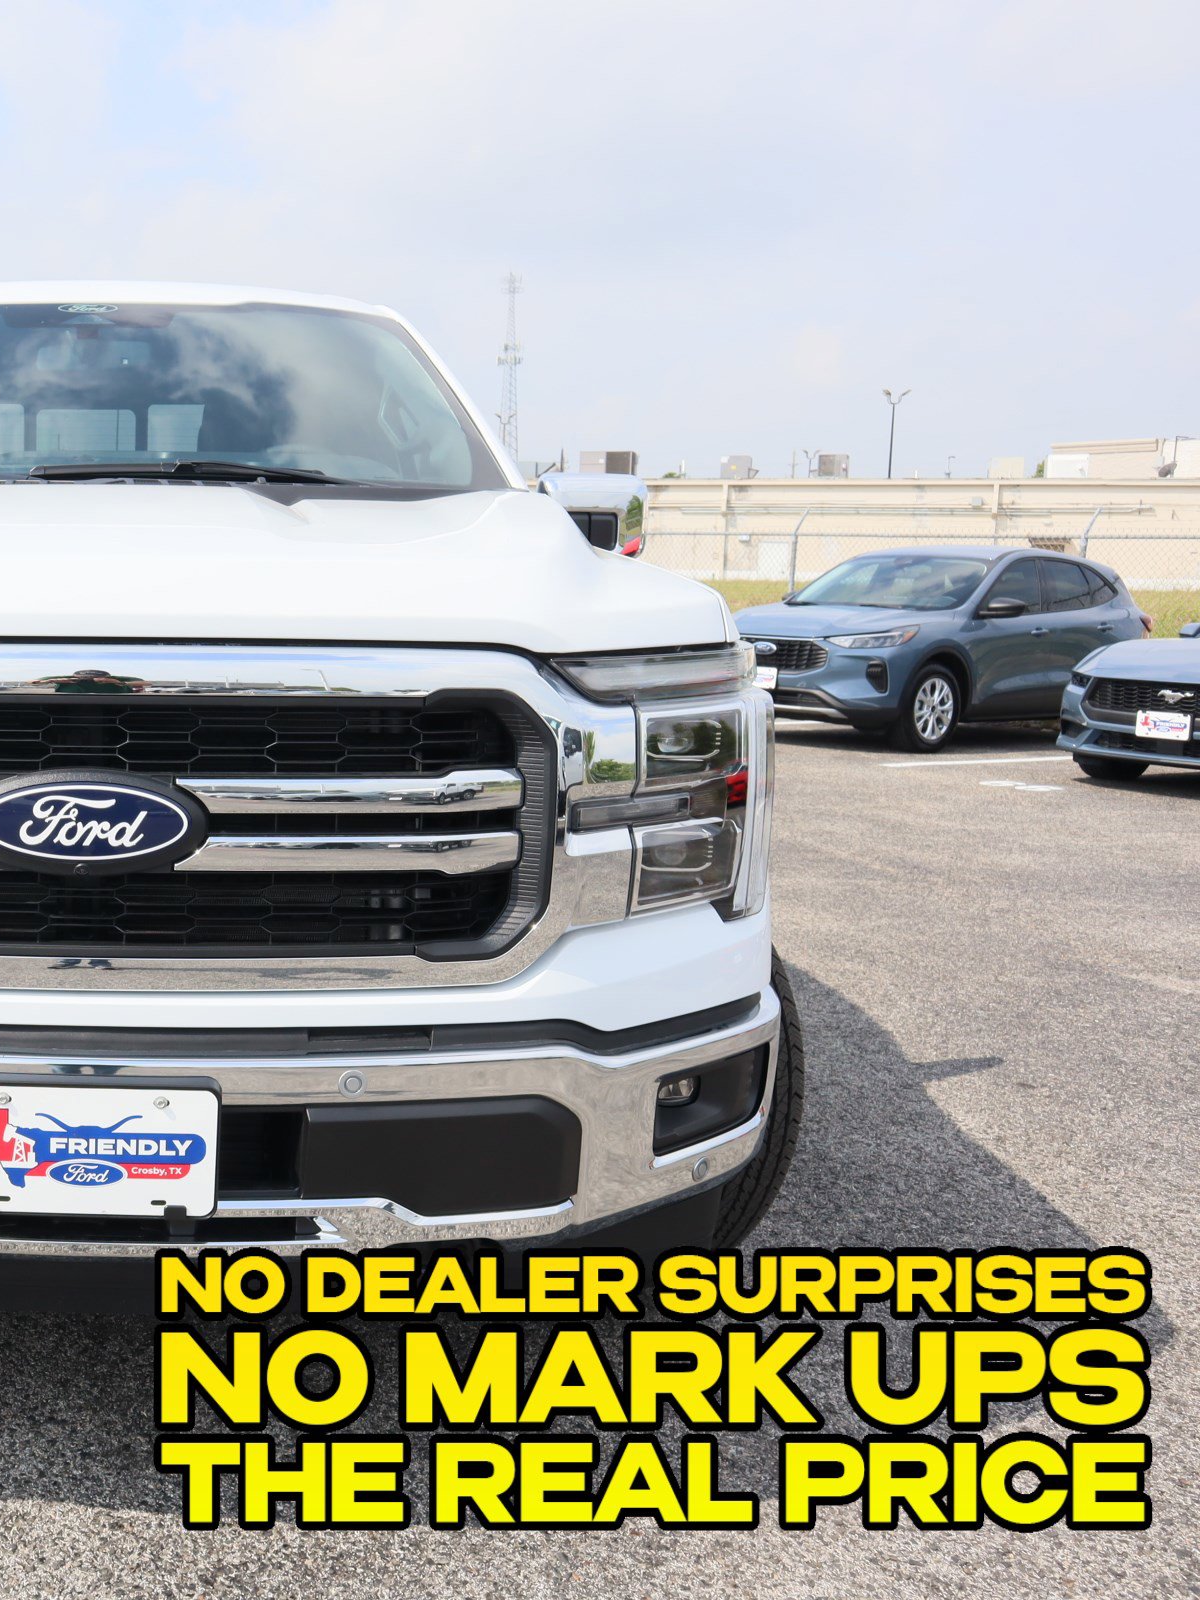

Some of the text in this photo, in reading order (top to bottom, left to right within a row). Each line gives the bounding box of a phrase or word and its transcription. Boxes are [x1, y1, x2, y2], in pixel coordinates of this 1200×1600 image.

[19, 795, 148, 847] Ford
[49, 1137, 193, 1157] FRIENDLY
[63, 1163, 109, 1184] Ford
[131, 1165, 182, 1177] Crosby, TX
